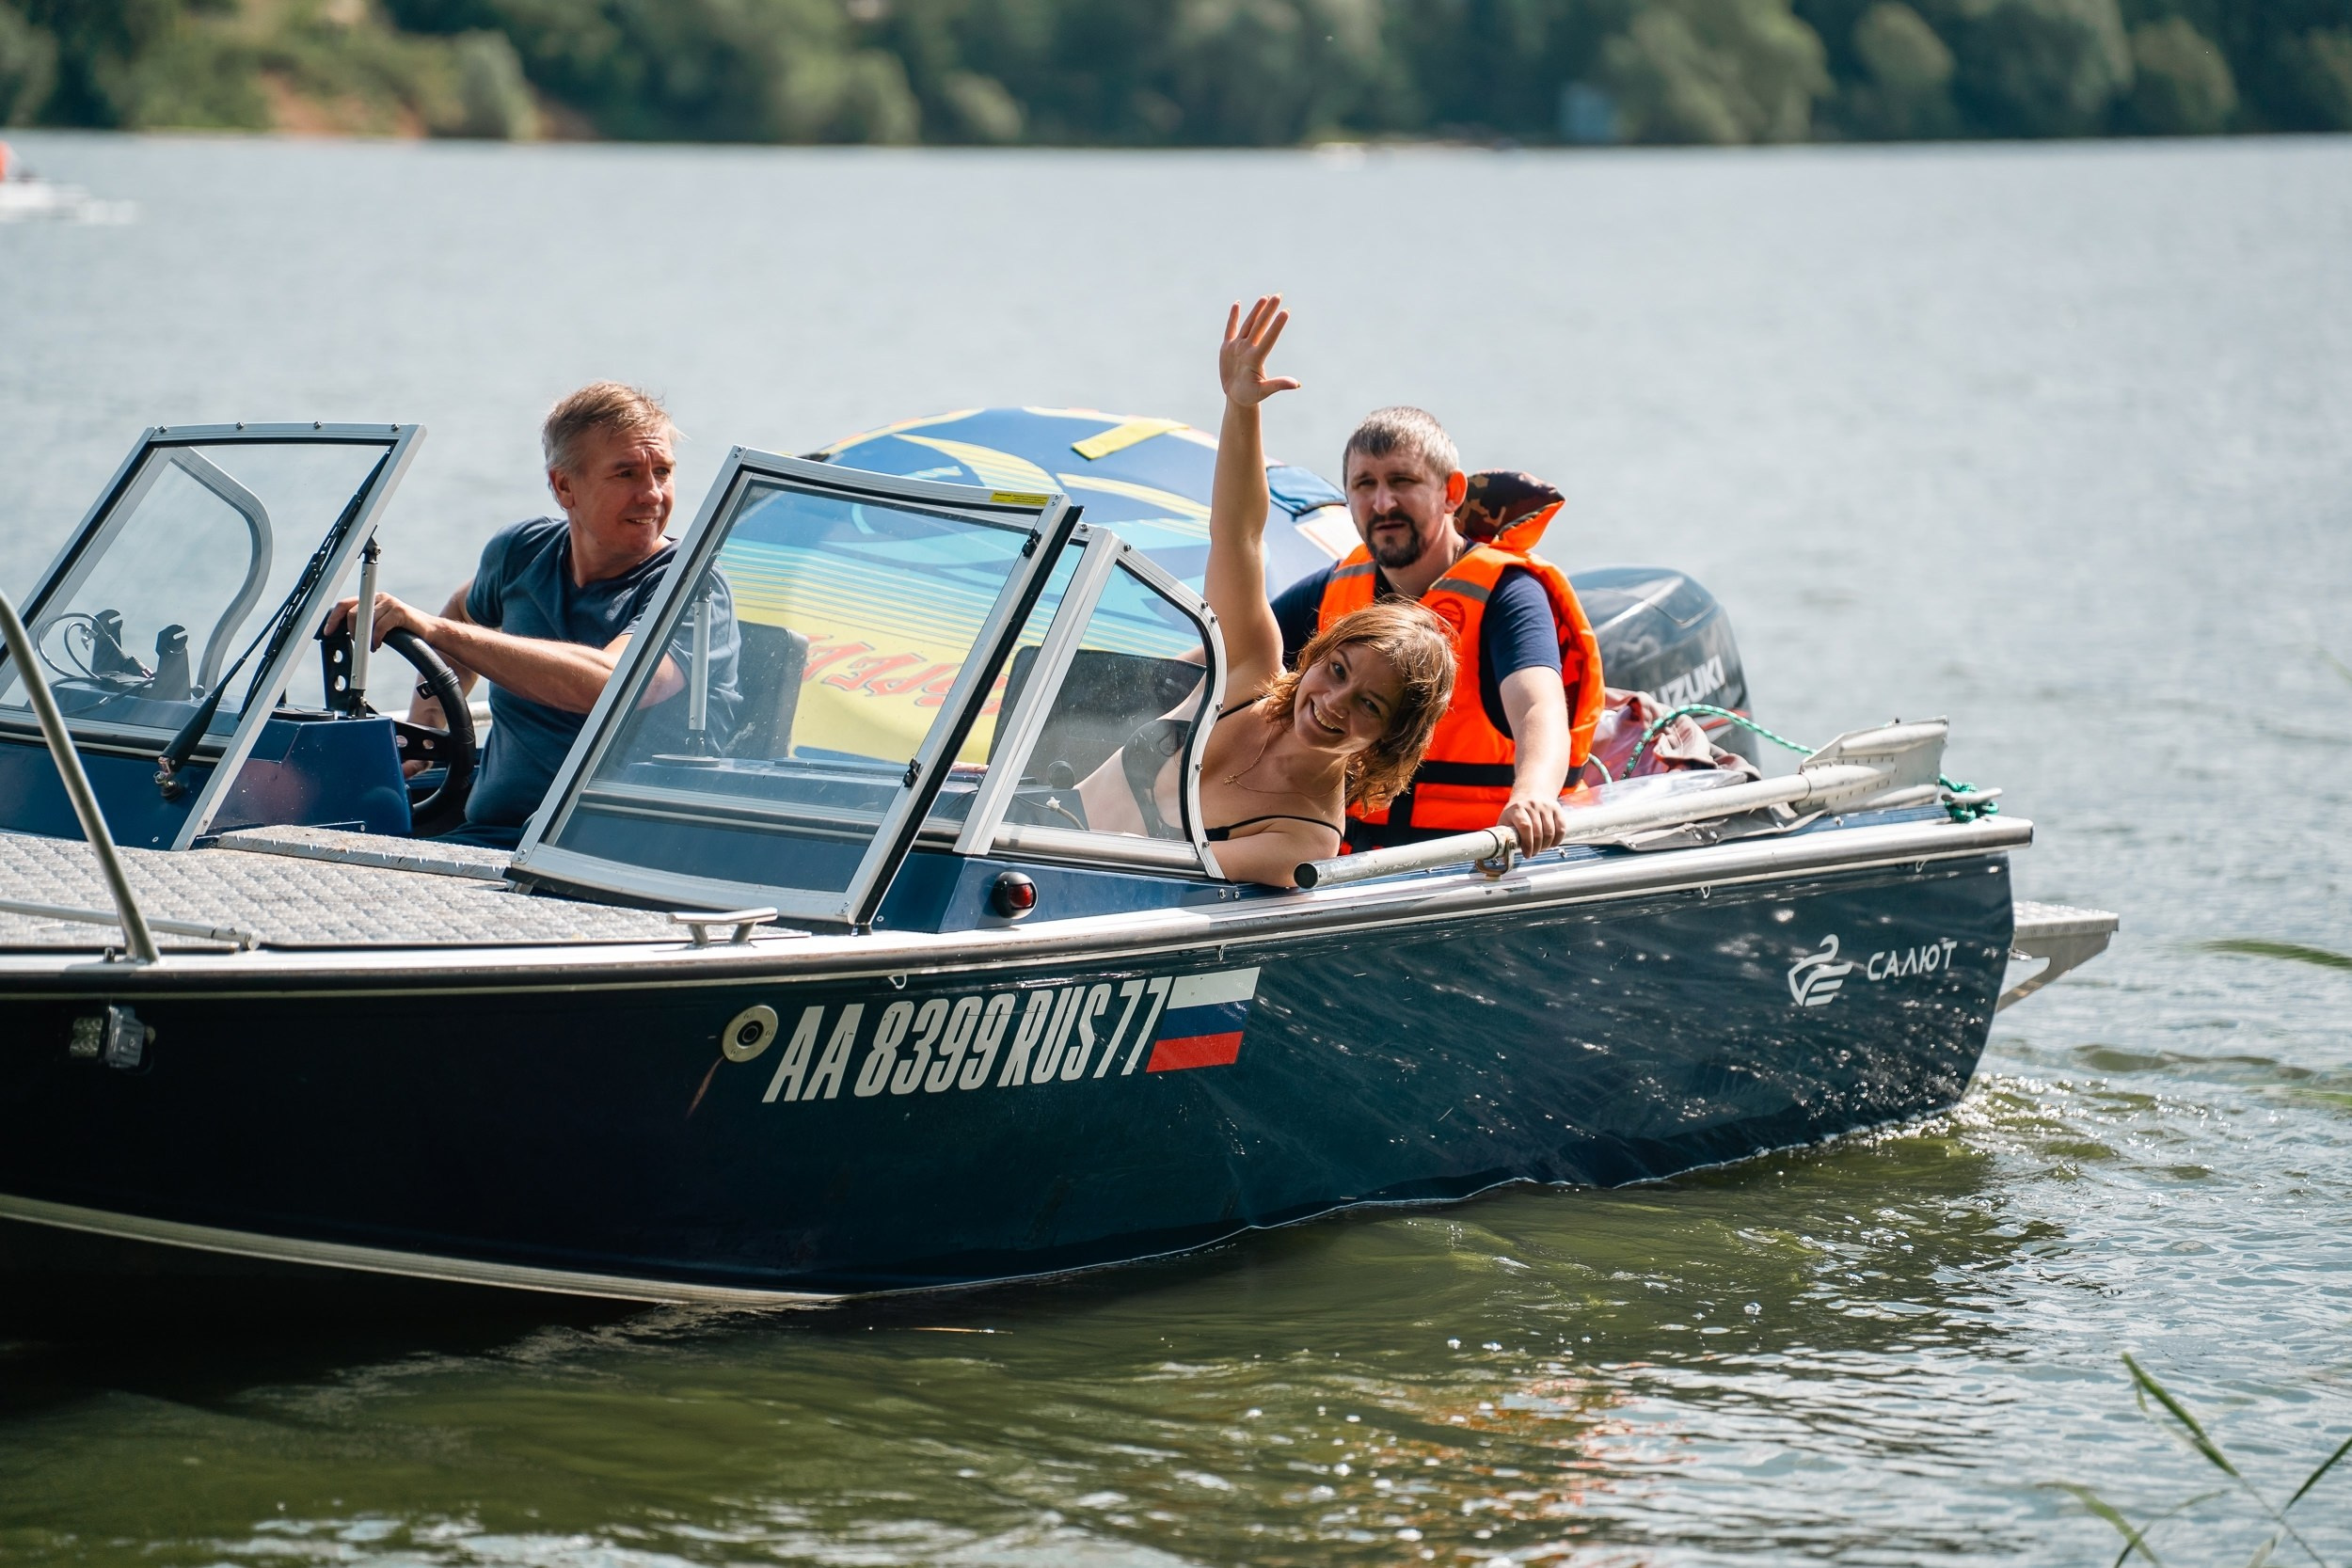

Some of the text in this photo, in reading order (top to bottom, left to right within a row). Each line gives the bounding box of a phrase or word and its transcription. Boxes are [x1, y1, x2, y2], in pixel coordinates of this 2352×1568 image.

[1648, 654, 1725, 707] UZUKI
[1867, 941, 1958, 981] САЛЮТ
[762, 975, 1173, 1103] AA 8399 RUS 77
